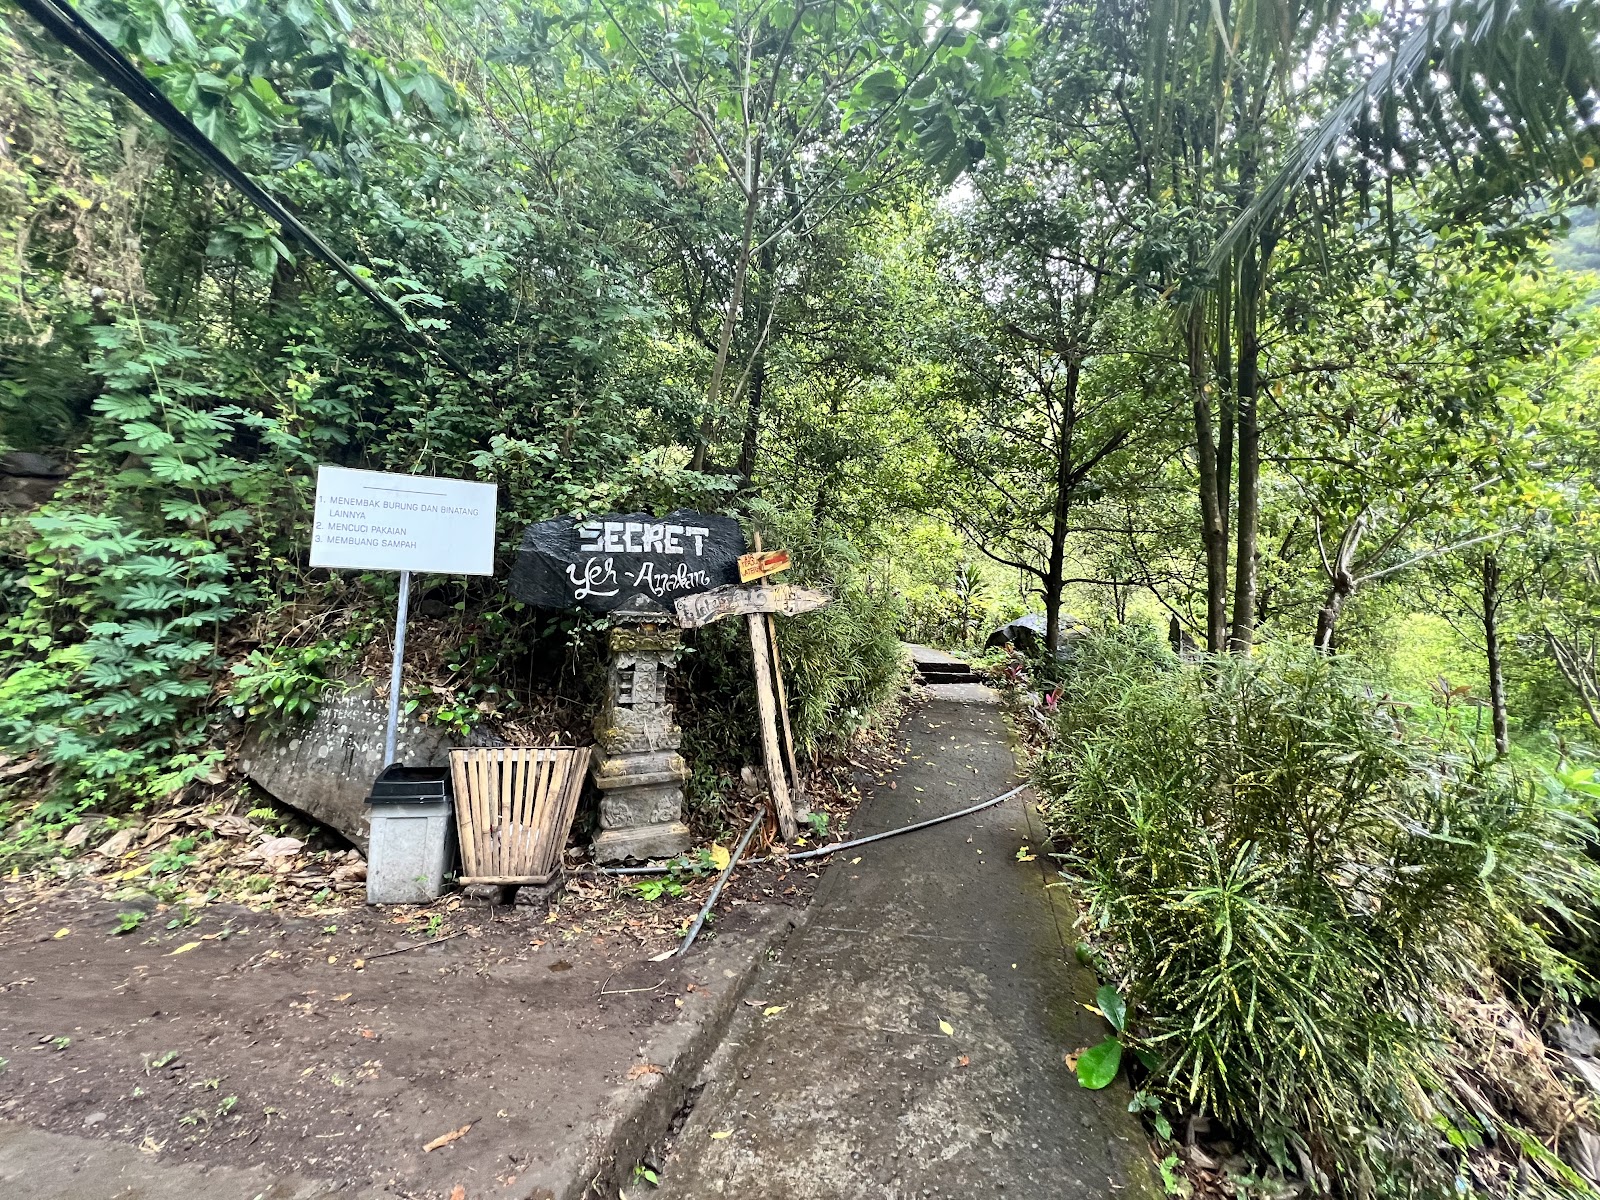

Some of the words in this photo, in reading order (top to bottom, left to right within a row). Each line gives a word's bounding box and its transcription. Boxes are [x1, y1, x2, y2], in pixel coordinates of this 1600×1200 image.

[319, 496, 326, 504] 1.
[330, 496, 380, 508] MENEMBAK
[383, 501, 418, 512] BURUNG
[421, 504, 438, 512] DAN
[441, 505, 479, 516] BINATANG
[329, 509, 366, 519] LAINNYA
[316, 521, 324, 530] 2.
[328, 522, 368, 533] MENCUCI
[371, 525, 407, 535] PAKAIAN
[314, 535, 323, 543] 3.
[327, 535, 379, 547] MEMBUANG
[381, 539, 417, 549] SAMPAH
[579, 521, 710, 556] SECRET
[566, 556, 620, 600] Yeh
